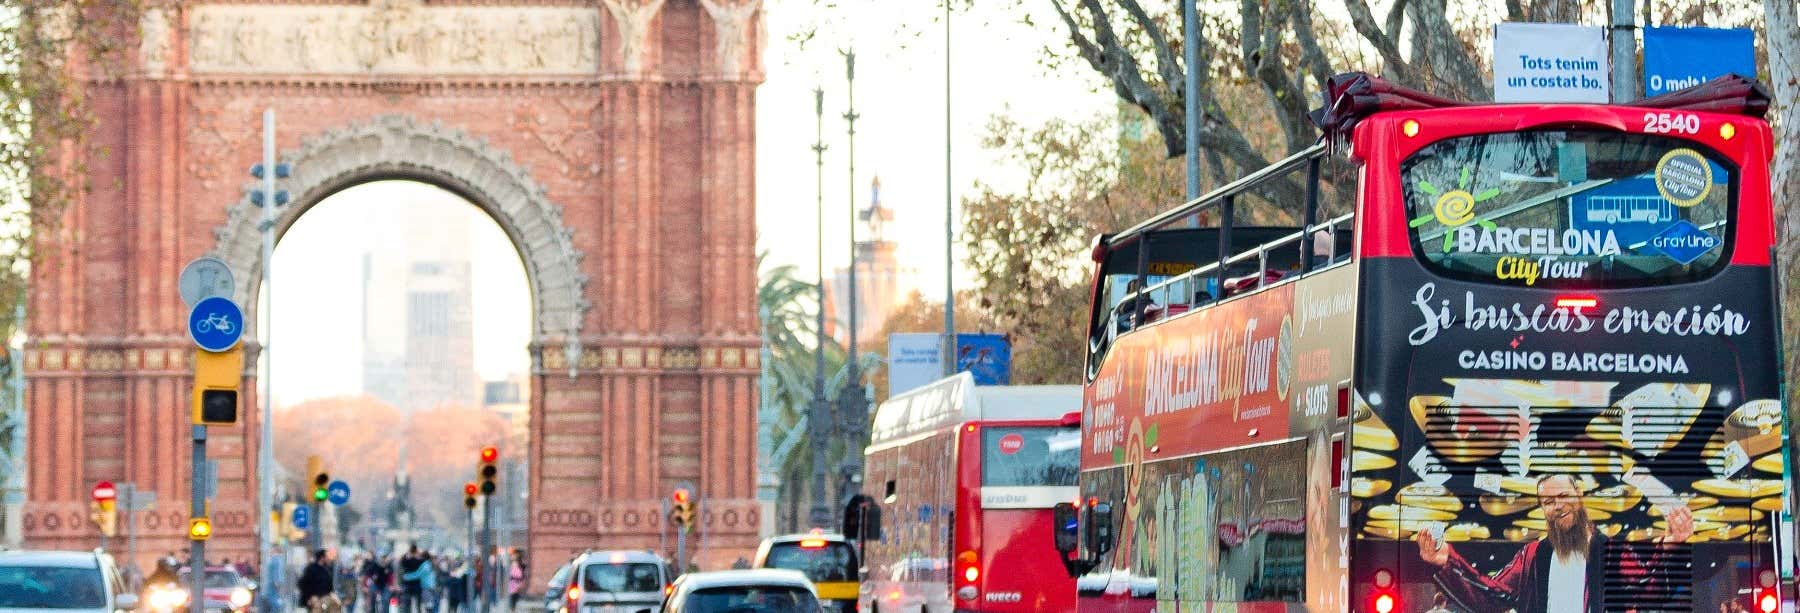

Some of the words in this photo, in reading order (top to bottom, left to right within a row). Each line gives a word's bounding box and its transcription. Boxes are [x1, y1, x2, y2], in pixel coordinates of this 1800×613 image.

[1519, 55, 1552, 70] Tots
[1556, 57, 1599, 71] tenim
[1507, 77, 1527, 88] un
[1531, 75, 1578, 88] costat
[1581, 74, 1603, 89] bo.
[1650, 74, 1663, 91] O
[1643, 113, 1700, 135] 2540
[1662, 167, 1705, 189] BARCELONA
[1670, 159, 1702, 175] OFFICIAL
[1458, 226, 1622, 256] BARCELONA
[1408, 282, 1456, 346] Si
[1464, 291, 1595, 333] buscas
[1603, 304, 1751, 337] emoción
[1144, 329, 1218, 417] BARCELONA
[1458, 350, 1546, 371] CASINO
[1551, 351, 1690, 374] BARCELONA
[1305, 383, 1329, 417] SLOTS
